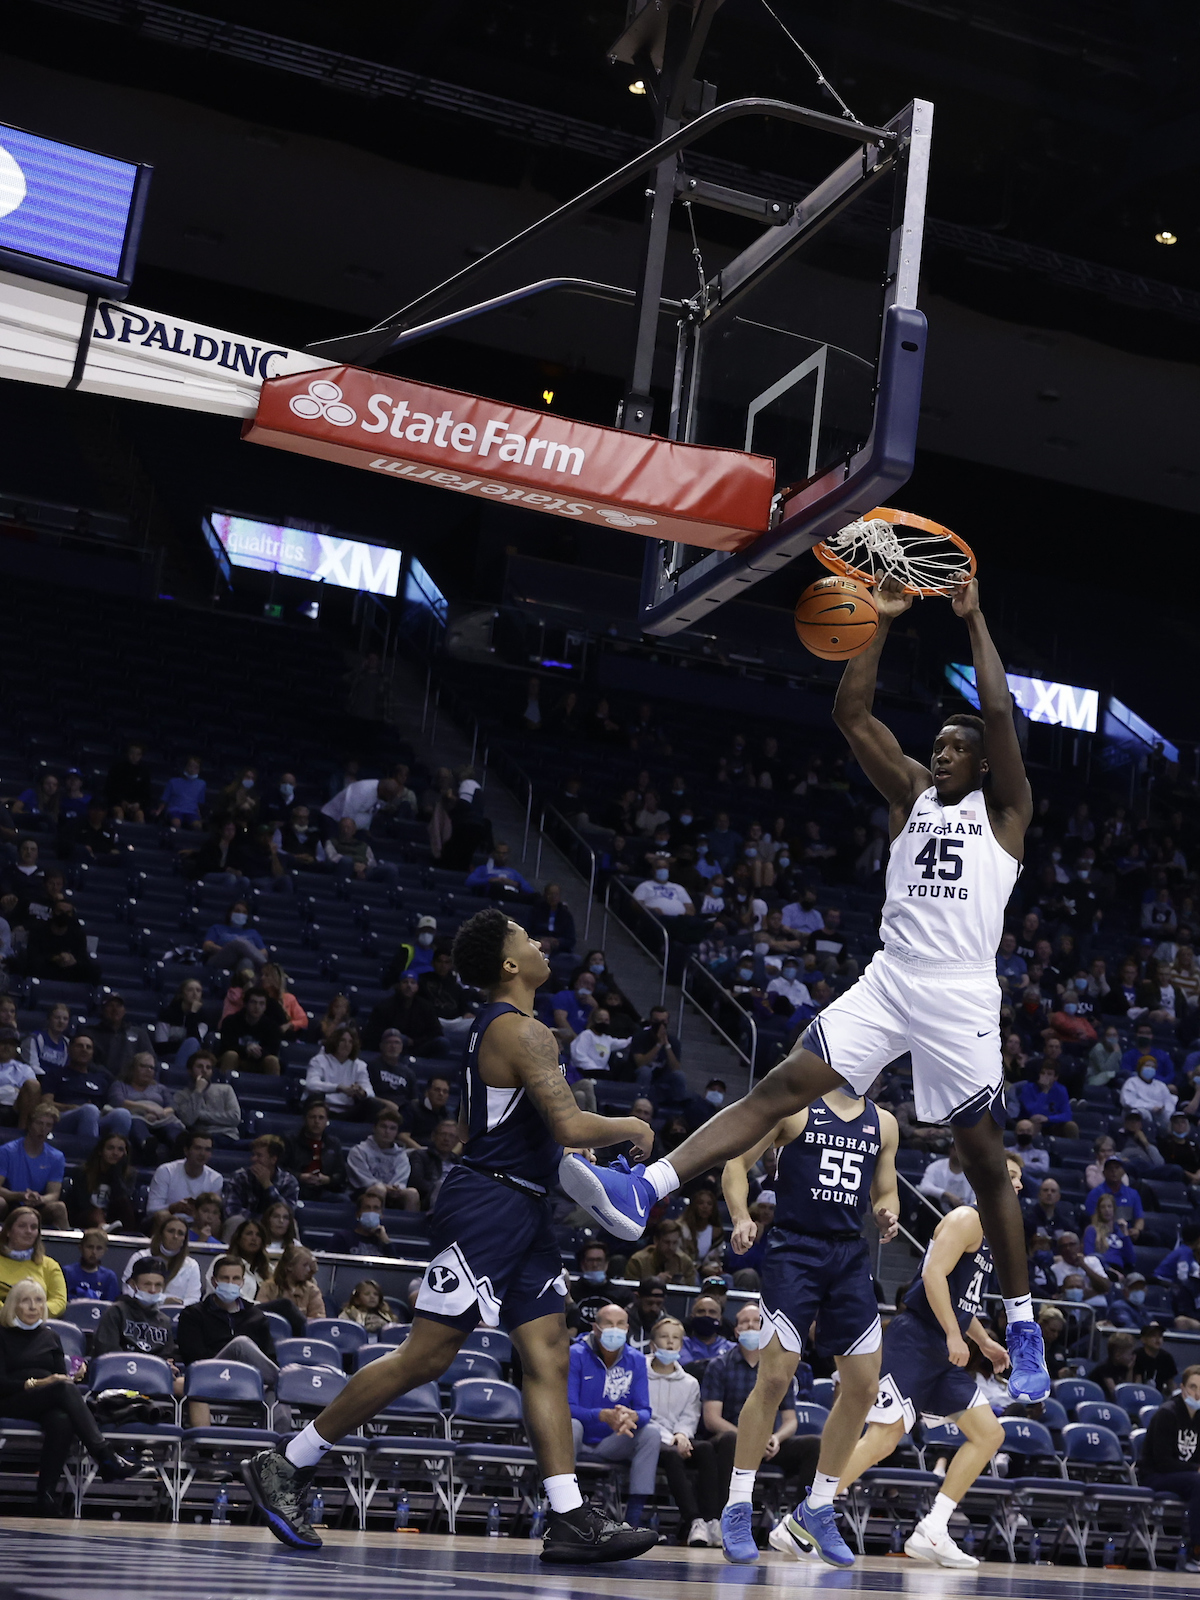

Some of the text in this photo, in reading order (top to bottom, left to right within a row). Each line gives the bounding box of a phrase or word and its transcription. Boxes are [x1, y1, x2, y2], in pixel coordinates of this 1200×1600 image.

[543, 389, 554, 405] 4
[311, 533, 402, 598] XM
[1029, 678, 1099, 733] XM
[914, 838, 964, 881] 45
[907, 884, 968, 900] YOUNG
[804, 1131, 880, 1156] BRIGHAM
[818, 1148, 865, 1191] 55
[91, 1307, 101, 1320] 3
[331, 1326, 340, 1337] 6
[481, 1336, 491, 1348] 8
[302, 1346, 312, 1358] 5
[126, 1361, 137, 1375] 3
[465, 1358, 475, 1370] 7
[219, 1368, 231, 1381] 4
[312, 1376, 322, 1388] 5
[483, 1388, 493, 1401] 7
[1073, 1386, 1085, 1397] 17
[798, 1411, 809, 1423] 11
[1097, 1408, 1111, 1421] 16
[944, 1422, 959, 1435] 13
[1016, 1425, 1031, 1438] 14
[1086, 1432, 1100, 1445] 15
